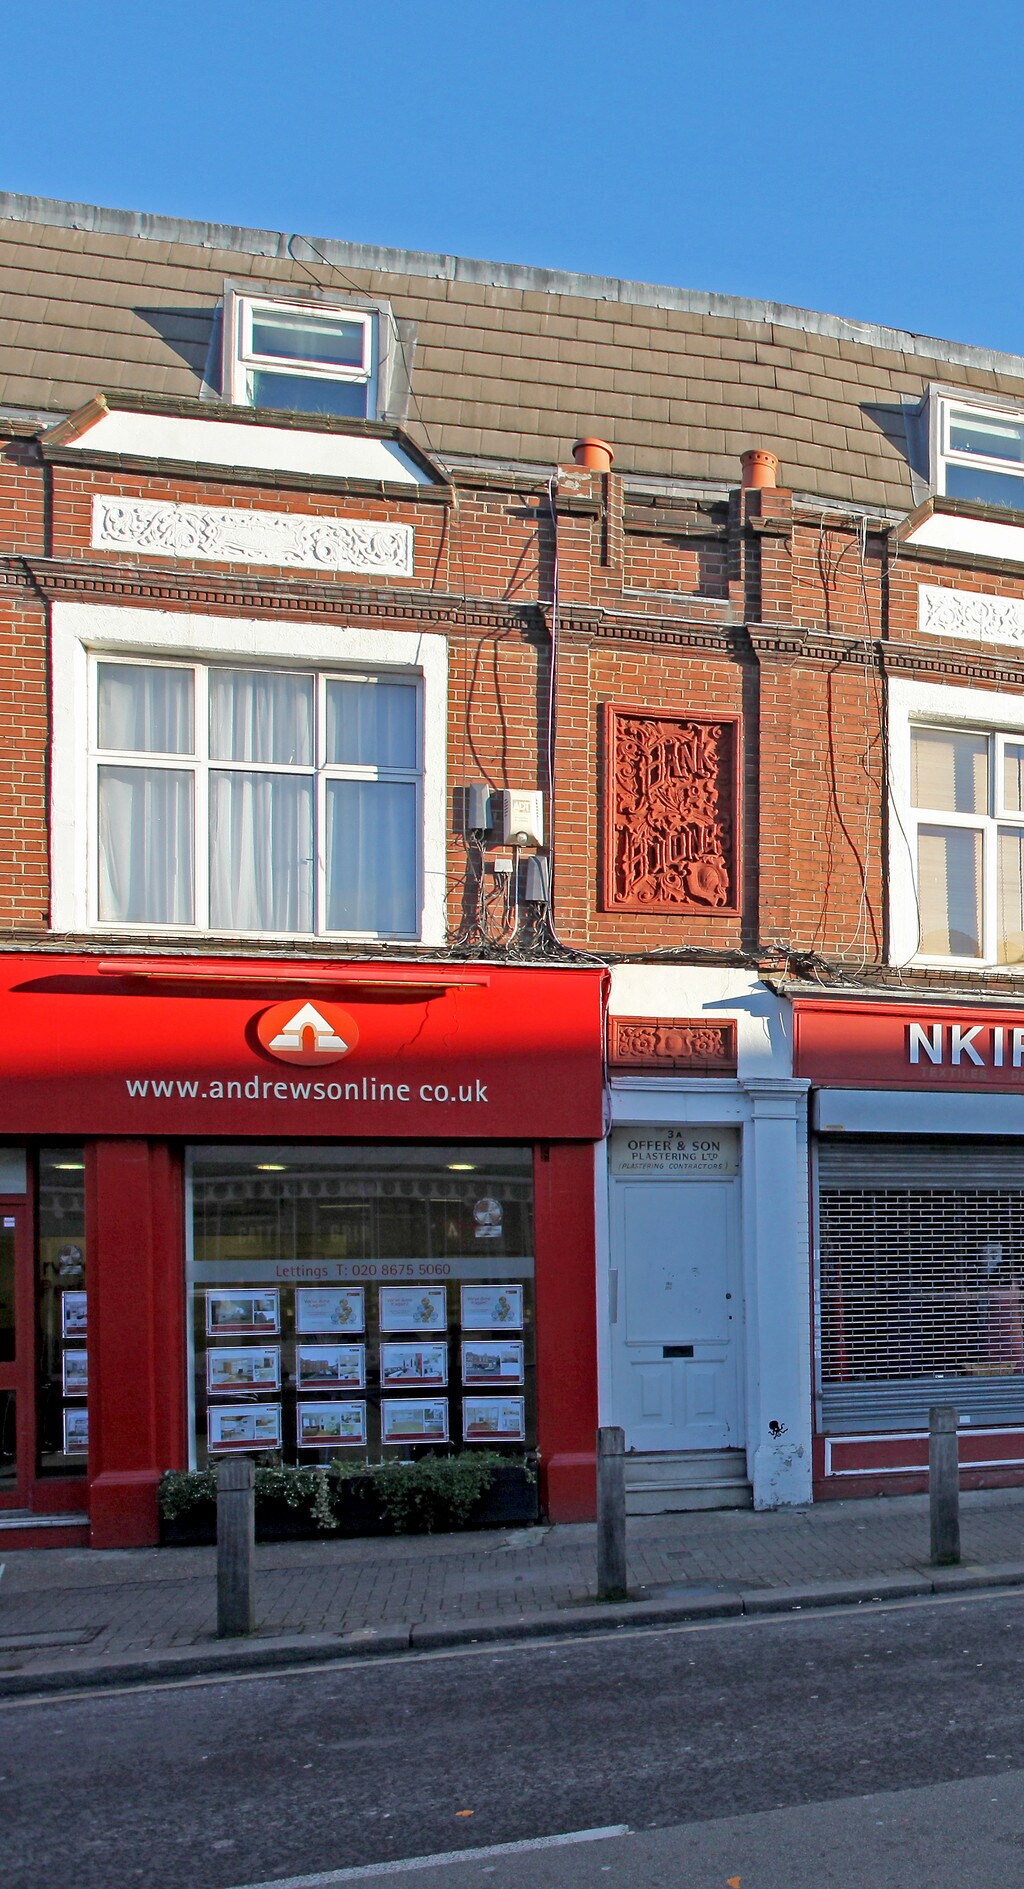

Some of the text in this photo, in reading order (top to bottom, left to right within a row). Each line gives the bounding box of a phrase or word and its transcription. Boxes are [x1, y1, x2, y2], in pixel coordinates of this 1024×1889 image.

[919, 1066, 988, 1080] TEXTILES
[628, 1140, 721, 1152] OFFER & SON
[632, 1152, 697, 1161] PLASTERING
[276, 1263, 451, 1279] Lettings T: 020 8675 5060
